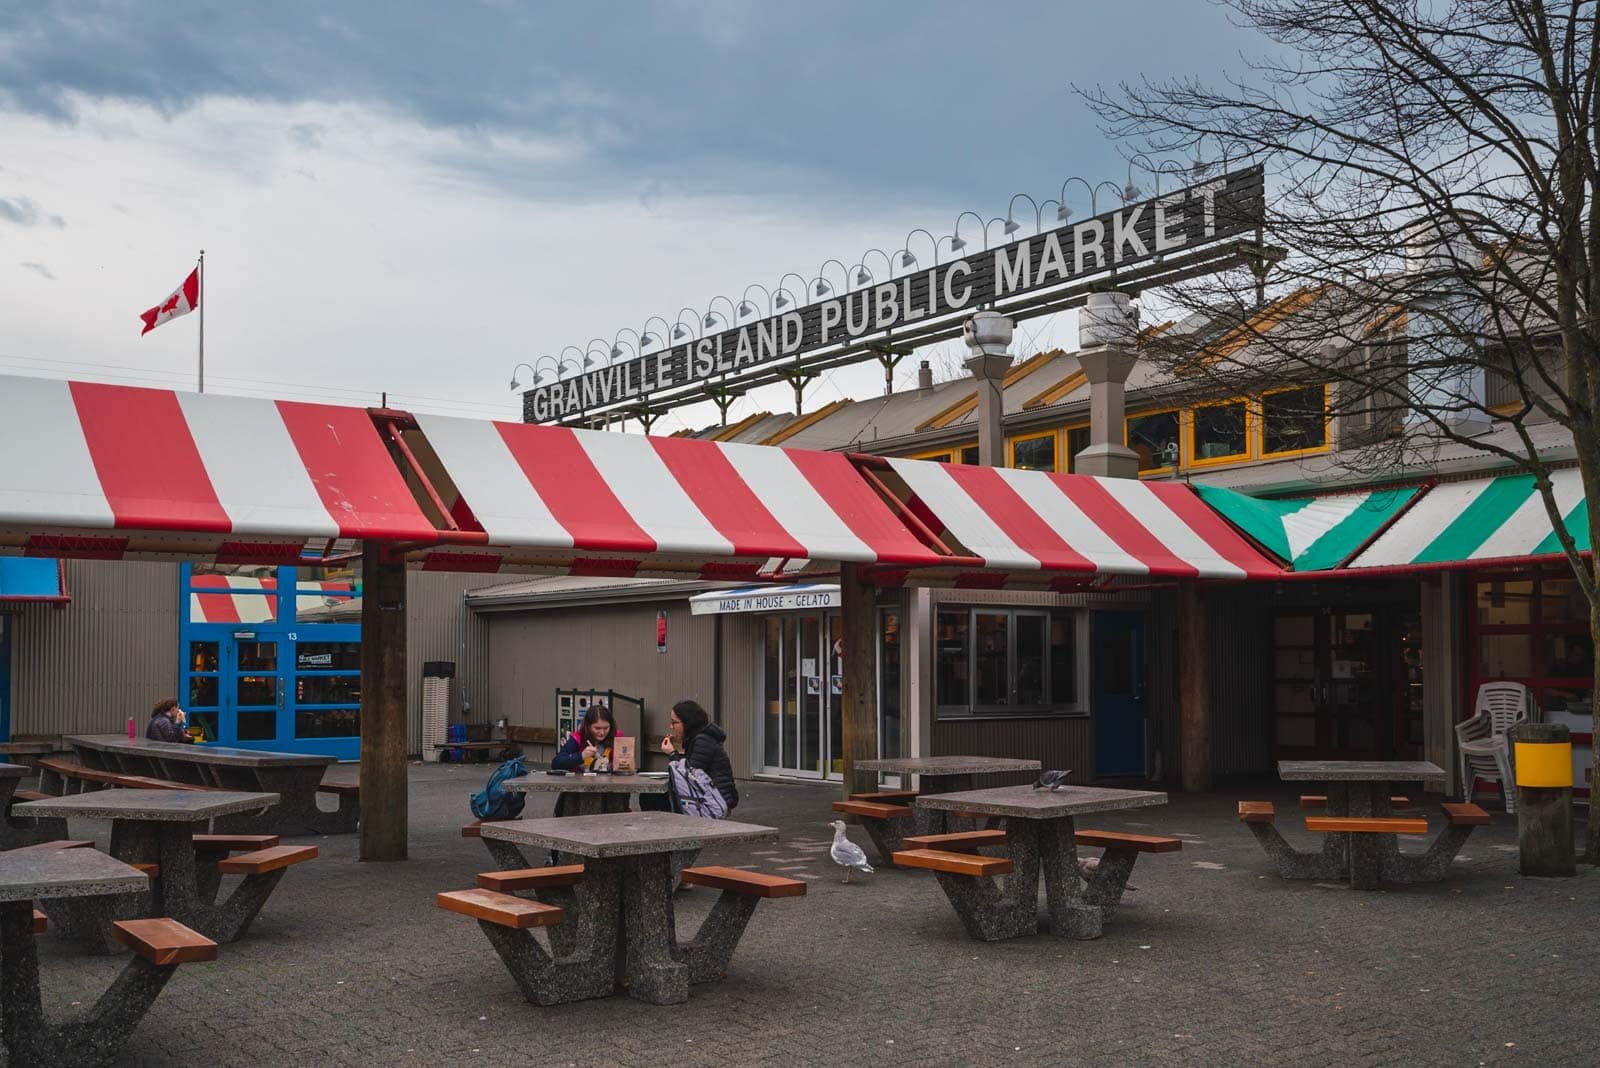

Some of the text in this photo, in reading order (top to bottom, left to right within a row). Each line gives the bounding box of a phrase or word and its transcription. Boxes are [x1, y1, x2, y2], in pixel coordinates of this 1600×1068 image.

[533, 179, 1228, 421] GRANVILLE ISLAND PUBLIC MARKET
[719, 599, 740, 611] MADE
[743, 599, 752, 609] IN
[756, 596, 784, 609] HOUSE
[796, 594, 831, 607] GELATO
[288, 632, 297, 640] 13
